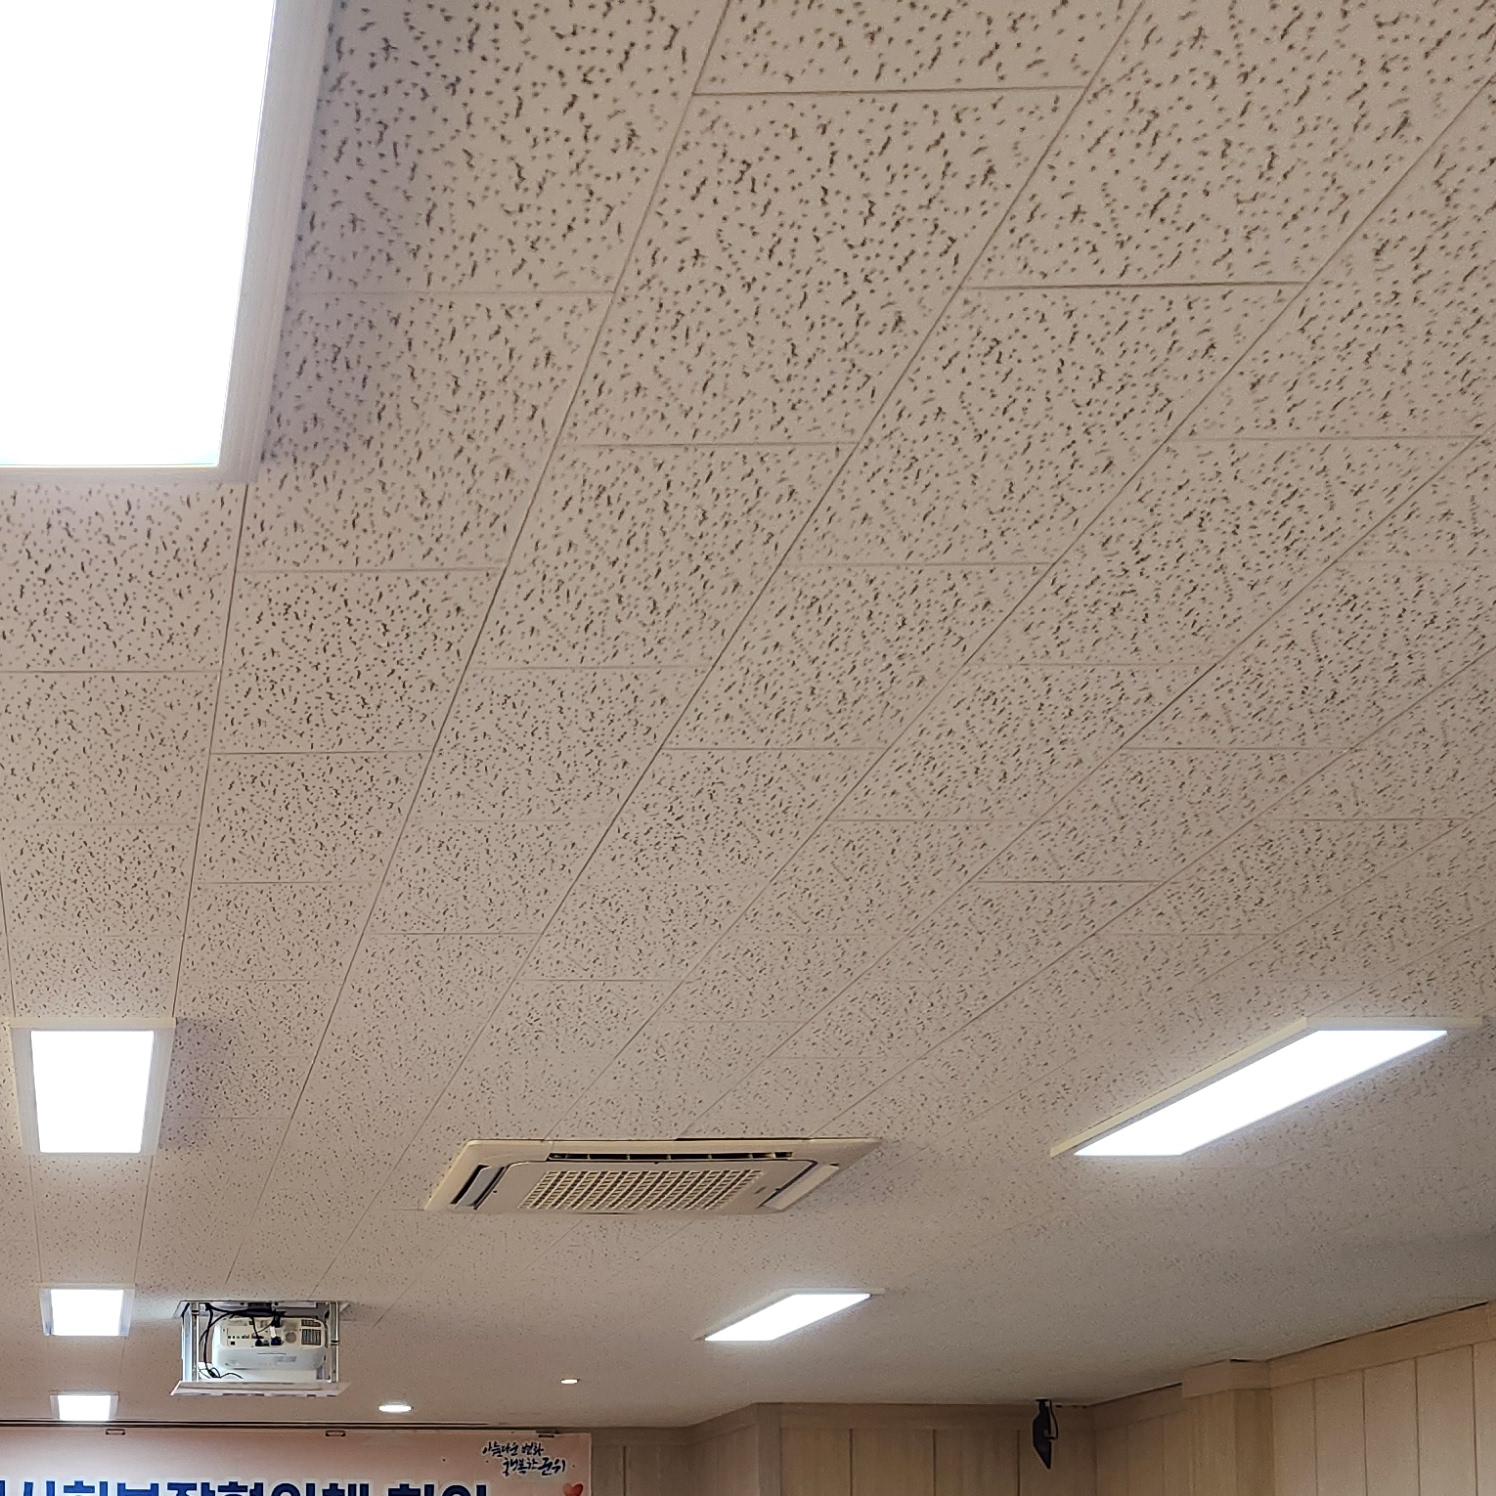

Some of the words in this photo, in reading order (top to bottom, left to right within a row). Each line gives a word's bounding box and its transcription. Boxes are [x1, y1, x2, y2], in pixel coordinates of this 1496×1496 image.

[482, 1441, 519, 1457] 아름다운
[522, 1442, 544, 1456] 변화
[538, 1457, 566, 1476] 군위
